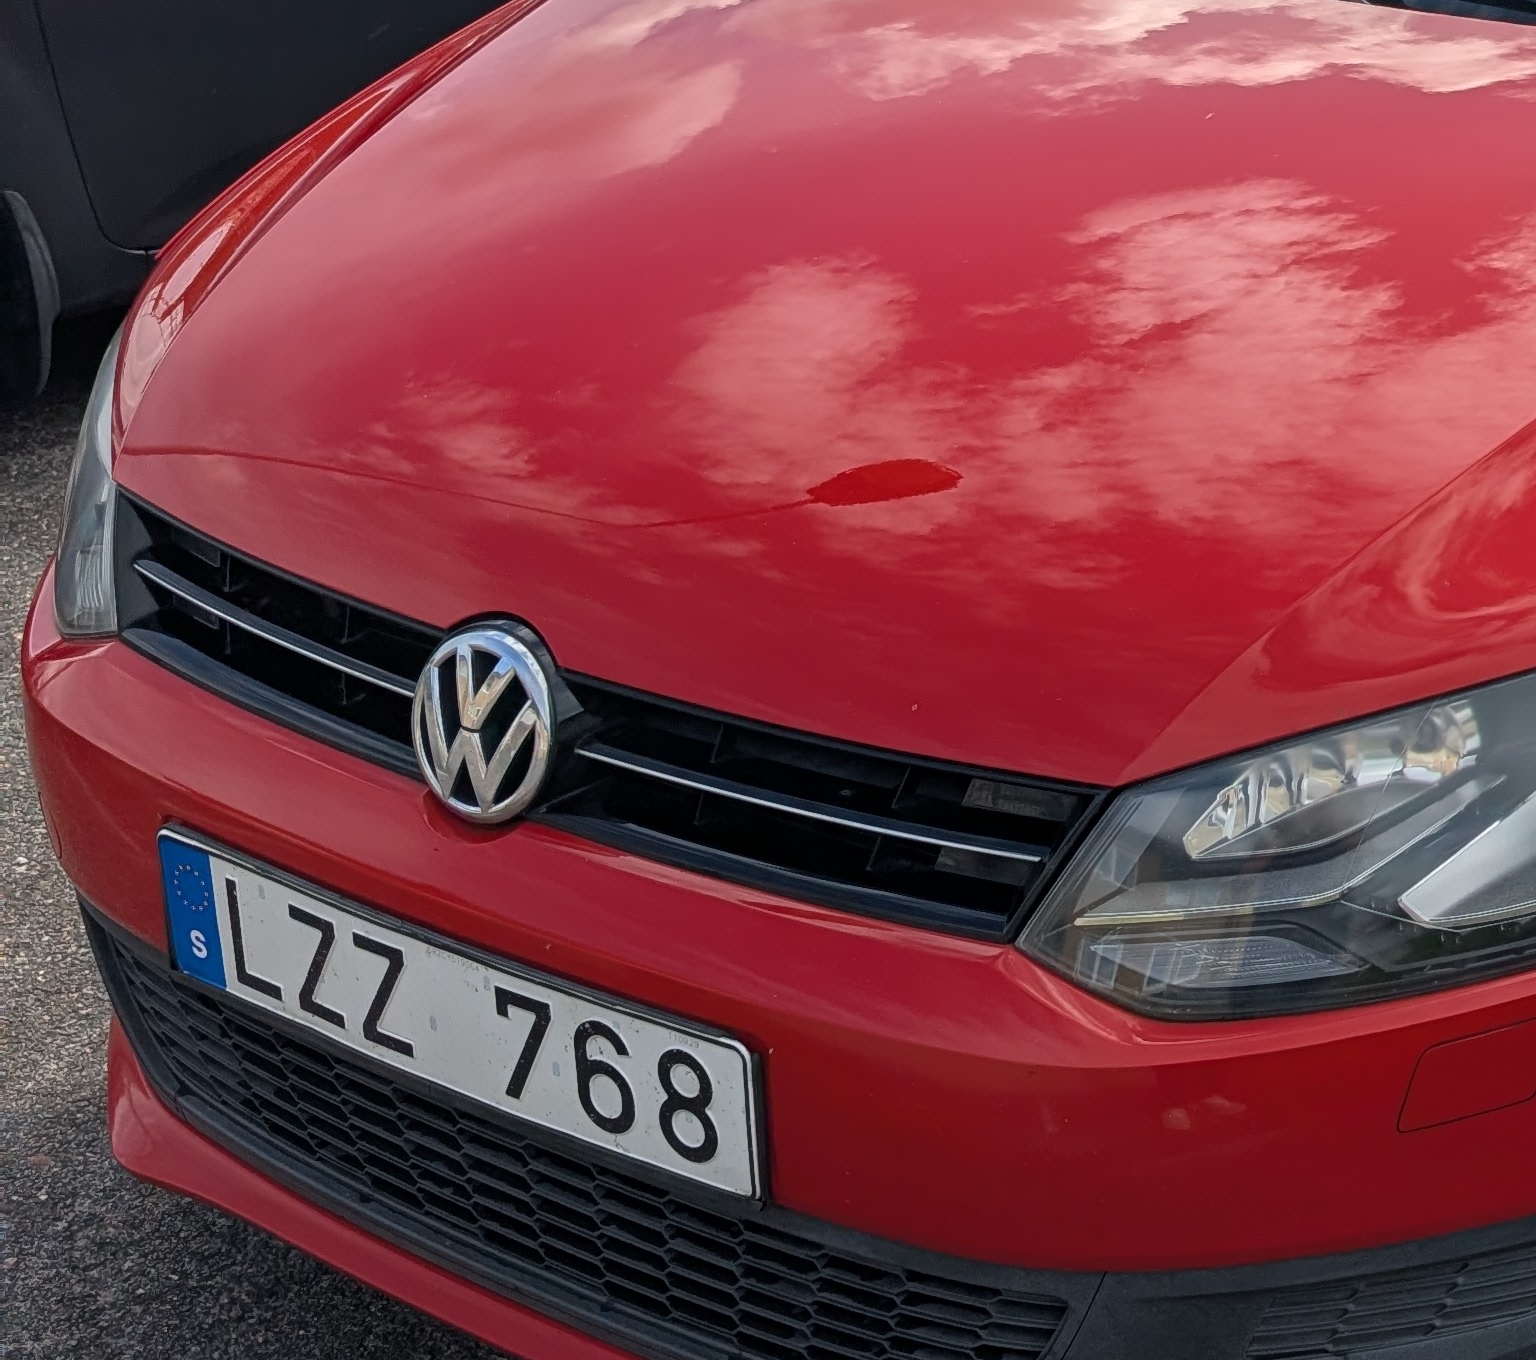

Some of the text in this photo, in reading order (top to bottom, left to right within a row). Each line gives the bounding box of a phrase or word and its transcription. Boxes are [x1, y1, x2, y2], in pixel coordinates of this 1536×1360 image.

[415, 633, 547, 821] VW
[189, 929, 208, 959] S
[224, 875, 719, 1164] LZZ 768
